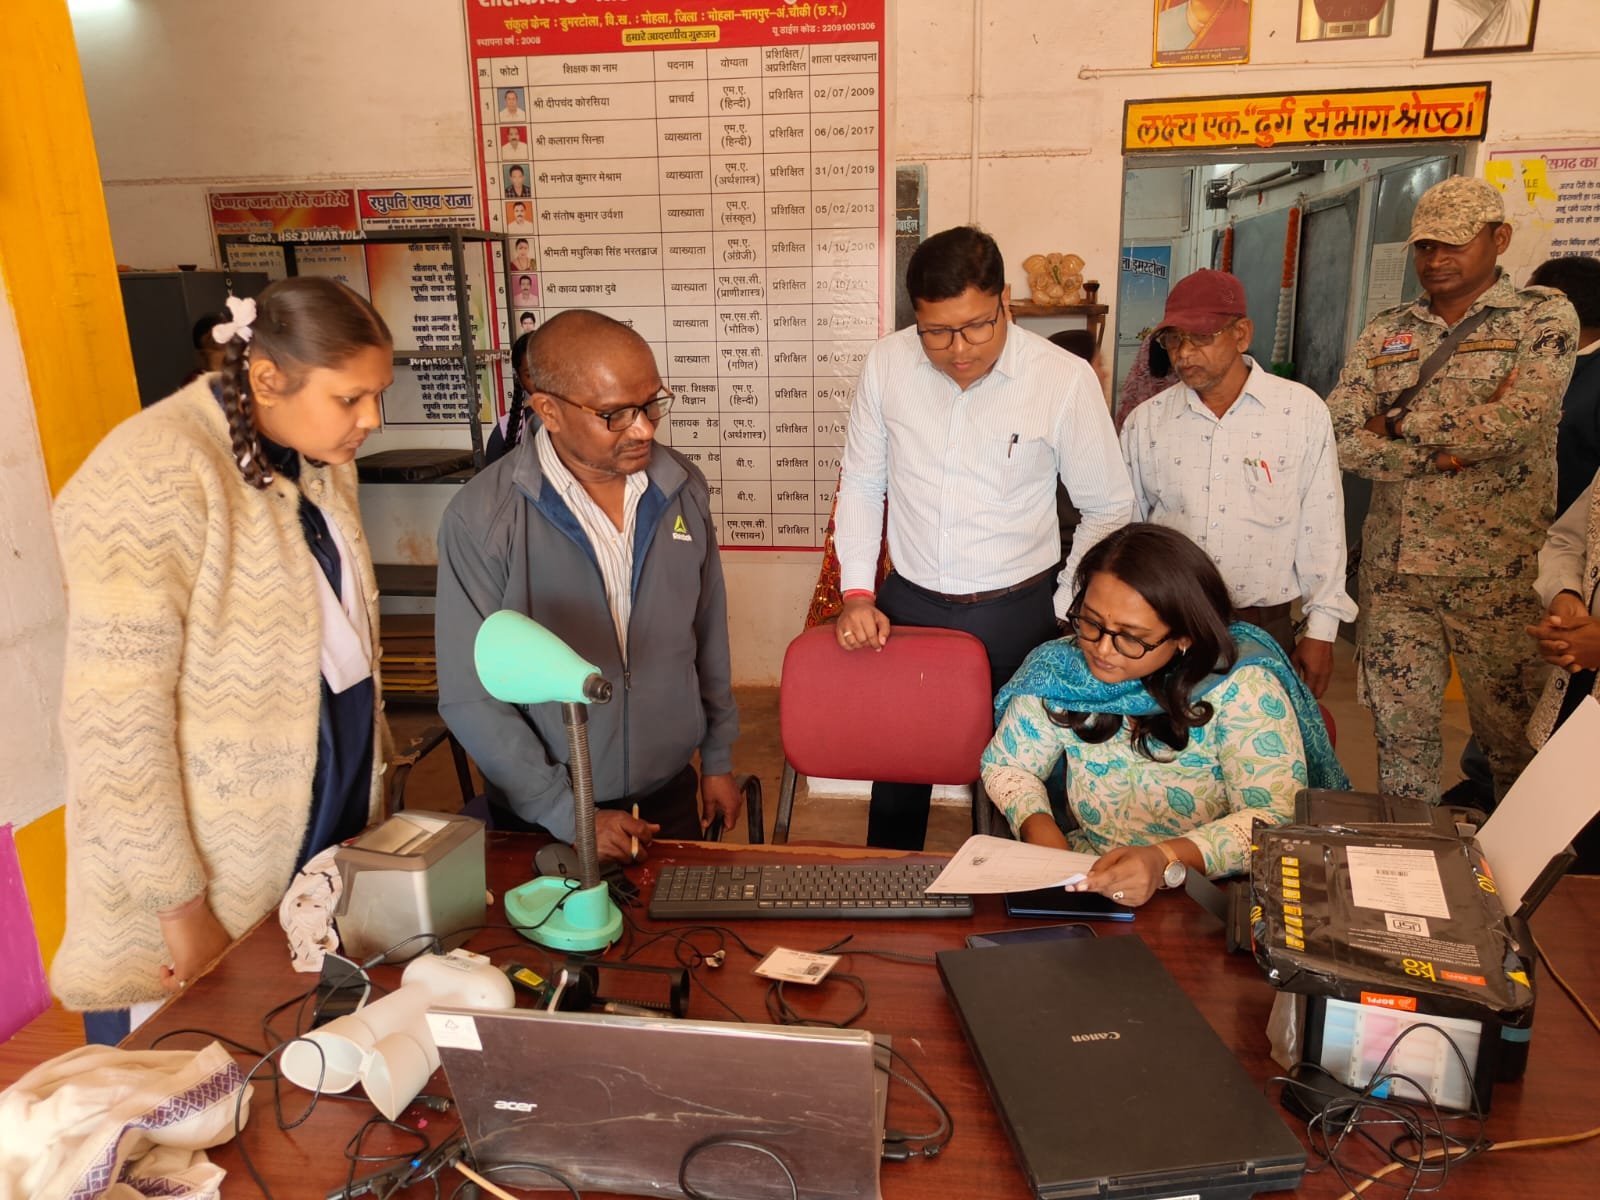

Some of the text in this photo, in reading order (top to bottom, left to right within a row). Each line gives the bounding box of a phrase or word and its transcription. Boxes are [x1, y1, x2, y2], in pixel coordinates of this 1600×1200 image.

[675, 9, 697, 23] जिला
[625, 30, 646, 42] हमारे
[647, 28, 688, 41] आदरणीय
[822, 23, 876, 33] 22091001306
[500, 66, 519, 77] फोटो
[563, 62, 588, 75] शिक्षक
[590, 64, 601, 73] का
[602, 63, 618, 72] नाम
[667, 60, 694, 70] पदनाम
[720, 57, 748, 67] योग्यता
[812, 54, 832, 64] शाला
[835, 52, 877, 63] पदस्थापना
[765, 61, 806, 73] अप्रशिक्षित
[534, 97, 545, 108] श्री
[546, 97, 573, 108] दीपचंद
[575, 96, 610, 107] कोरसिया
[669, 91, 694, 103] प्राचार्य
[723, 86, 746, 96] एम.ए.
[769, 88, 803, 100] प्रशिक्षित
[814, 86, 874, 99] 02/07/2009
[720, 97, 751, 110] (हिन्दी)
[1304, 99, 1396, 138] संभाग
[488, 123, 874, 148] 2 श्री कलाराम सिन्हा व्याख्याता एम.ए. प्रशिक्षित 06/06/2017
[721, 135, 752, 148] (हिन्दी)
[1580, 157, 1598, 169] का
[490, 162, 874, 185] 3 श्री मनोज कुमार मेश्राम व्याख्याता एम.ए. प्रशिक्षित 31/01/2019
[714, 174, 761, 187] (अर्थशास्त्र)
[368, 192, 473, 214] रघुपति राघव राजा
[493, 214, 498, 222] 4
[541, 210, 552, 221] श्री
[554, 209, 575, 221] संतोष
[577, 209, 598, 222] कुमार
[667, 208, 705, 218] व्याख्याता
[727, 201, 749, 210] एम.ए.
[771, 204, 805, 215] प्रशिक्षित
[816, 202, 874, 215] 05/02/2013
[721, 211, 756, 225] (संस्कृत)
[496, 250, 501, 258] 5
[544, 246, 568, 258] श्रीमती
[570, 246, 604, 259] मधुलिका
[605, 245, 621, 256] सिंह
[669, 246, 706, 255] व्याख्याता
[727, 238, 750, 248] एम.ए.
[771, 241, 806, 253] प्रशिक्षित
[723, 248, 756, 262] (अंग्रेजी)
[499, 286, 504, 294] 6
[547, 283, 557, 293] श्री
[558, 284, 577, 293] काव्य
[579, 283, 603, 293] प्रकाश
[671, 282, 707, 292] व्याख्याता
[719, 275, 761, 286] एम.एस.सी.
[772, 279, 806, 290] प्रशिक्षित
[716, 287, 765, 300] (प्राणीशास्त्र)
[673, 318, 708, 328] व्याख्याता
[720, 311, 762, 322] एम.एस.सी.
[773, 317, 806, 328] प्रशिक्षित
[724, 323, 759, 336] (भौतिक)
[674, 354, 710, 364] व्याख्याता
[721, 347, 763, 357] एम.एस.सी.
[774, 351, 807, 362] प्रशिक्षित
[727, 359, 758, 371] (गणित)
[691, 382, 716, 392] शिक्षक
[732, 383, 754, 393] एम.ए.
[775, 388, 807, 399] प्रशिक्षित
[682, 394, 758, 406] विज्ञान (हिन्दी)
[671, 418, 700, 428] सहायक
[706, 417, 719, 428] ग्रेड
[734, 418, 755, 428] एम.ए.
[775, 422, 808, 433] प्रशिक्षित
[693, 429, 767, 442] 2 (अर्थशास्त्र)
[708, 452, 720, 462] ग्रेड
[736, 457, 755, 468] बी.ए.
[776, 457, 809, 468] प्रशिक्षित
[737, 491, 756, 502] बी.ए.
[777, 490, 809, 502] प्रशिक्षित
[727, 519, 767, 529] एम.एस.सी.
[778, 525, 809, 536] प्रशिक्षित
[731, 530, 765, 541] (रसायन)
[1071, 1031, 1121, 1042] Canon
[494, 1100, 538, 1112] acer
